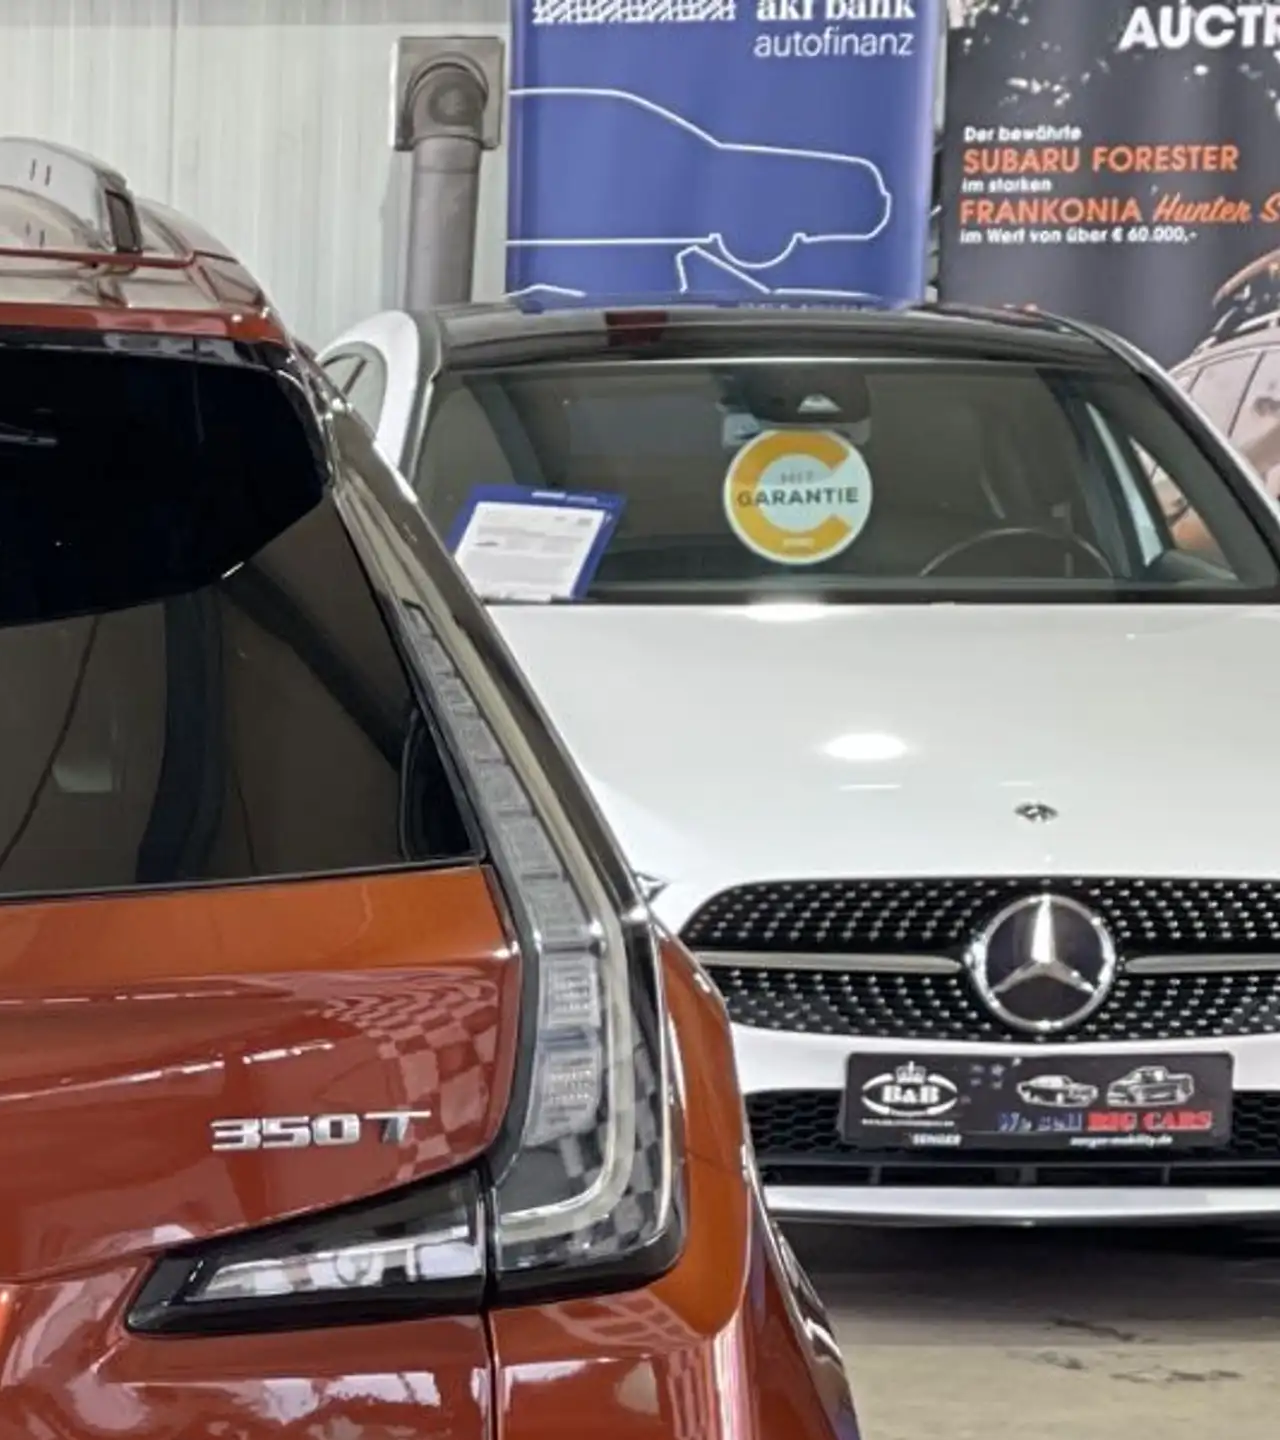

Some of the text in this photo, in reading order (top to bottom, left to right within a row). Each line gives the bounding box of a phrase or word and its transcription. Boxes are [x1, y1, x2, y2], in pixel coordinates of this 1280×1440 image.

[753, 26, 914, 57] autofinanz
[963, 125, 1083, 142] Der bewährte
[962, 145, 1240, 174] SUBARU FORESTER
[961, 177, 1052, 193] im starken
[959, 198, 1143, 225] FRANKONIA
[1151, 192, 1252, 223] Hunter
[960, 229, 983, 244] im
[987, 228, 1027, 244] Wert
[1030, 231, 1063, 244] von
[1066, 227, 1108, 244] über
[736, 487, 861, 507] GARANTIE
[209, 1110, 432, 1151] 350T
[1142, 1110, 1213, 1132] CARS
